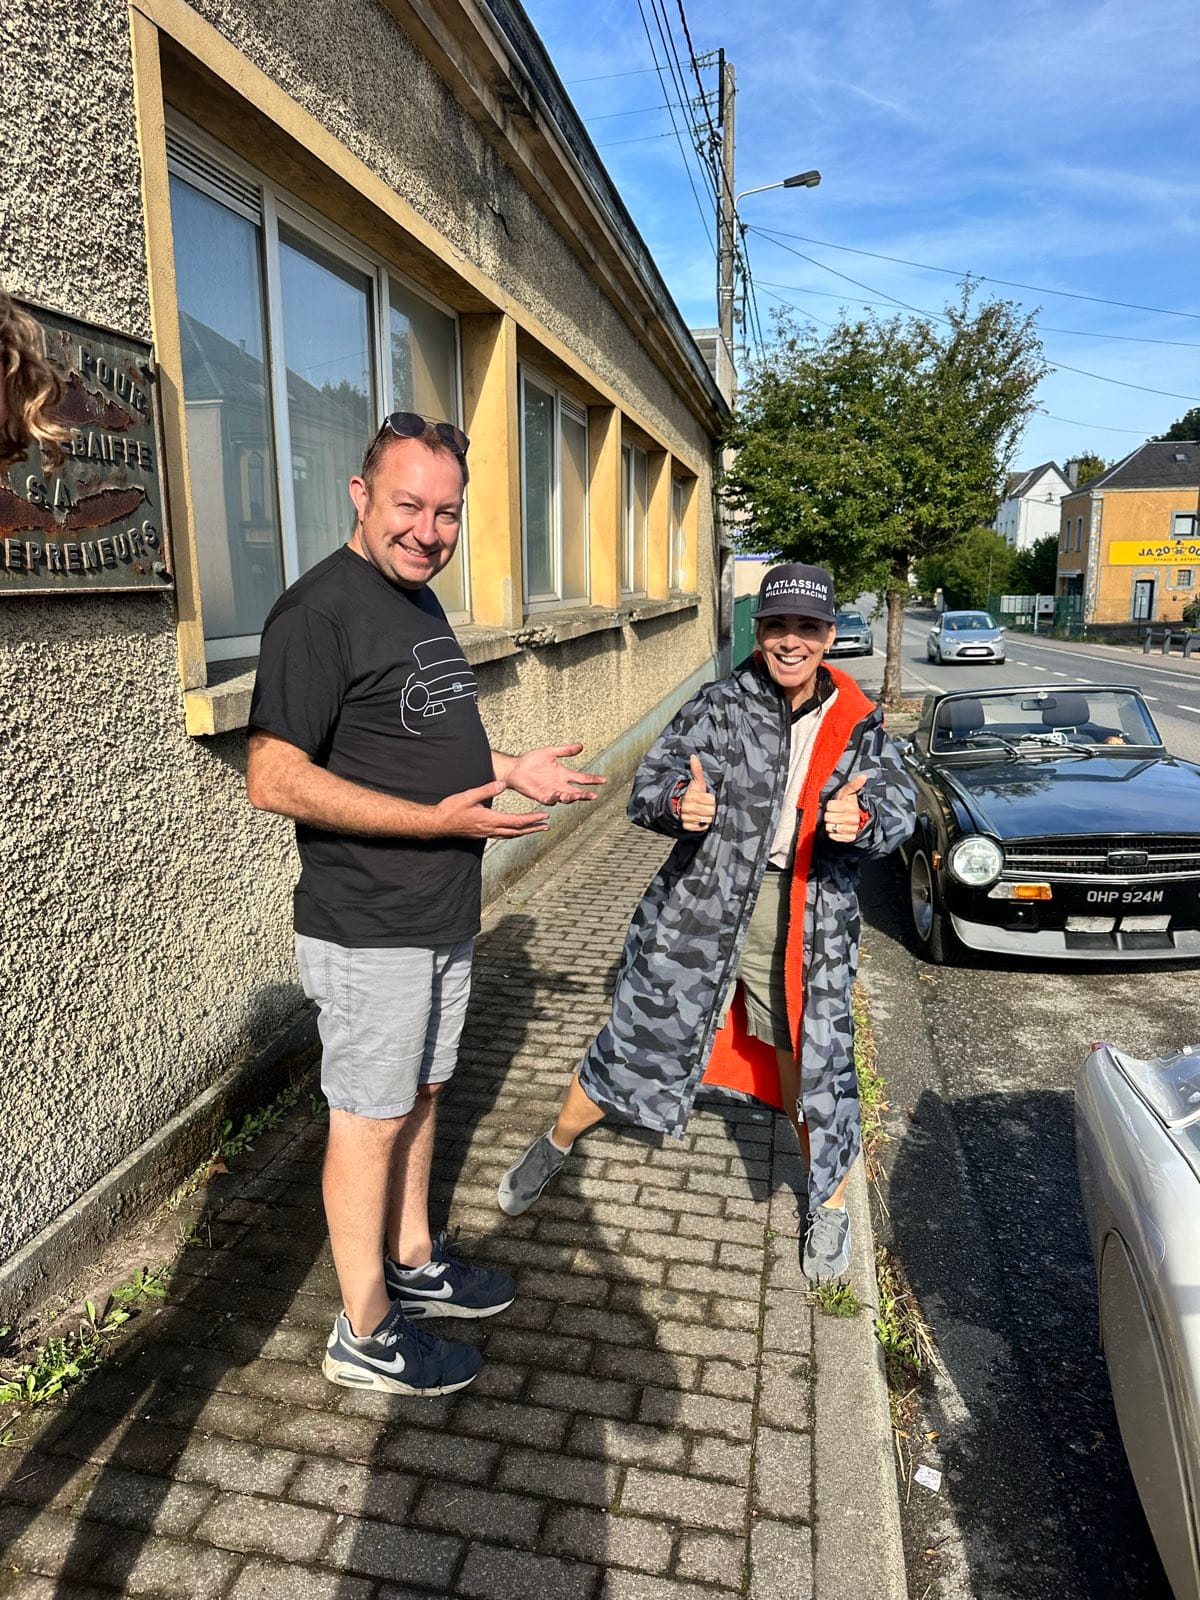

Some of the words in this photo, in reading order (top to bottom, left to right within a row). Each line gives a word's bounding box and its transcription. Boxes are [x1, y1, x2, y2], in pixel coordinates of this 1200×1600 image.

[772, 578, 828, 594] ATLASSIAN
[765, 587, 800, 598] WILLIAMS
[800, 588, 827, 601] RACING
[1087, 890, 1119, 903] OHP
[1121, 890, 1164, 903] 924M
